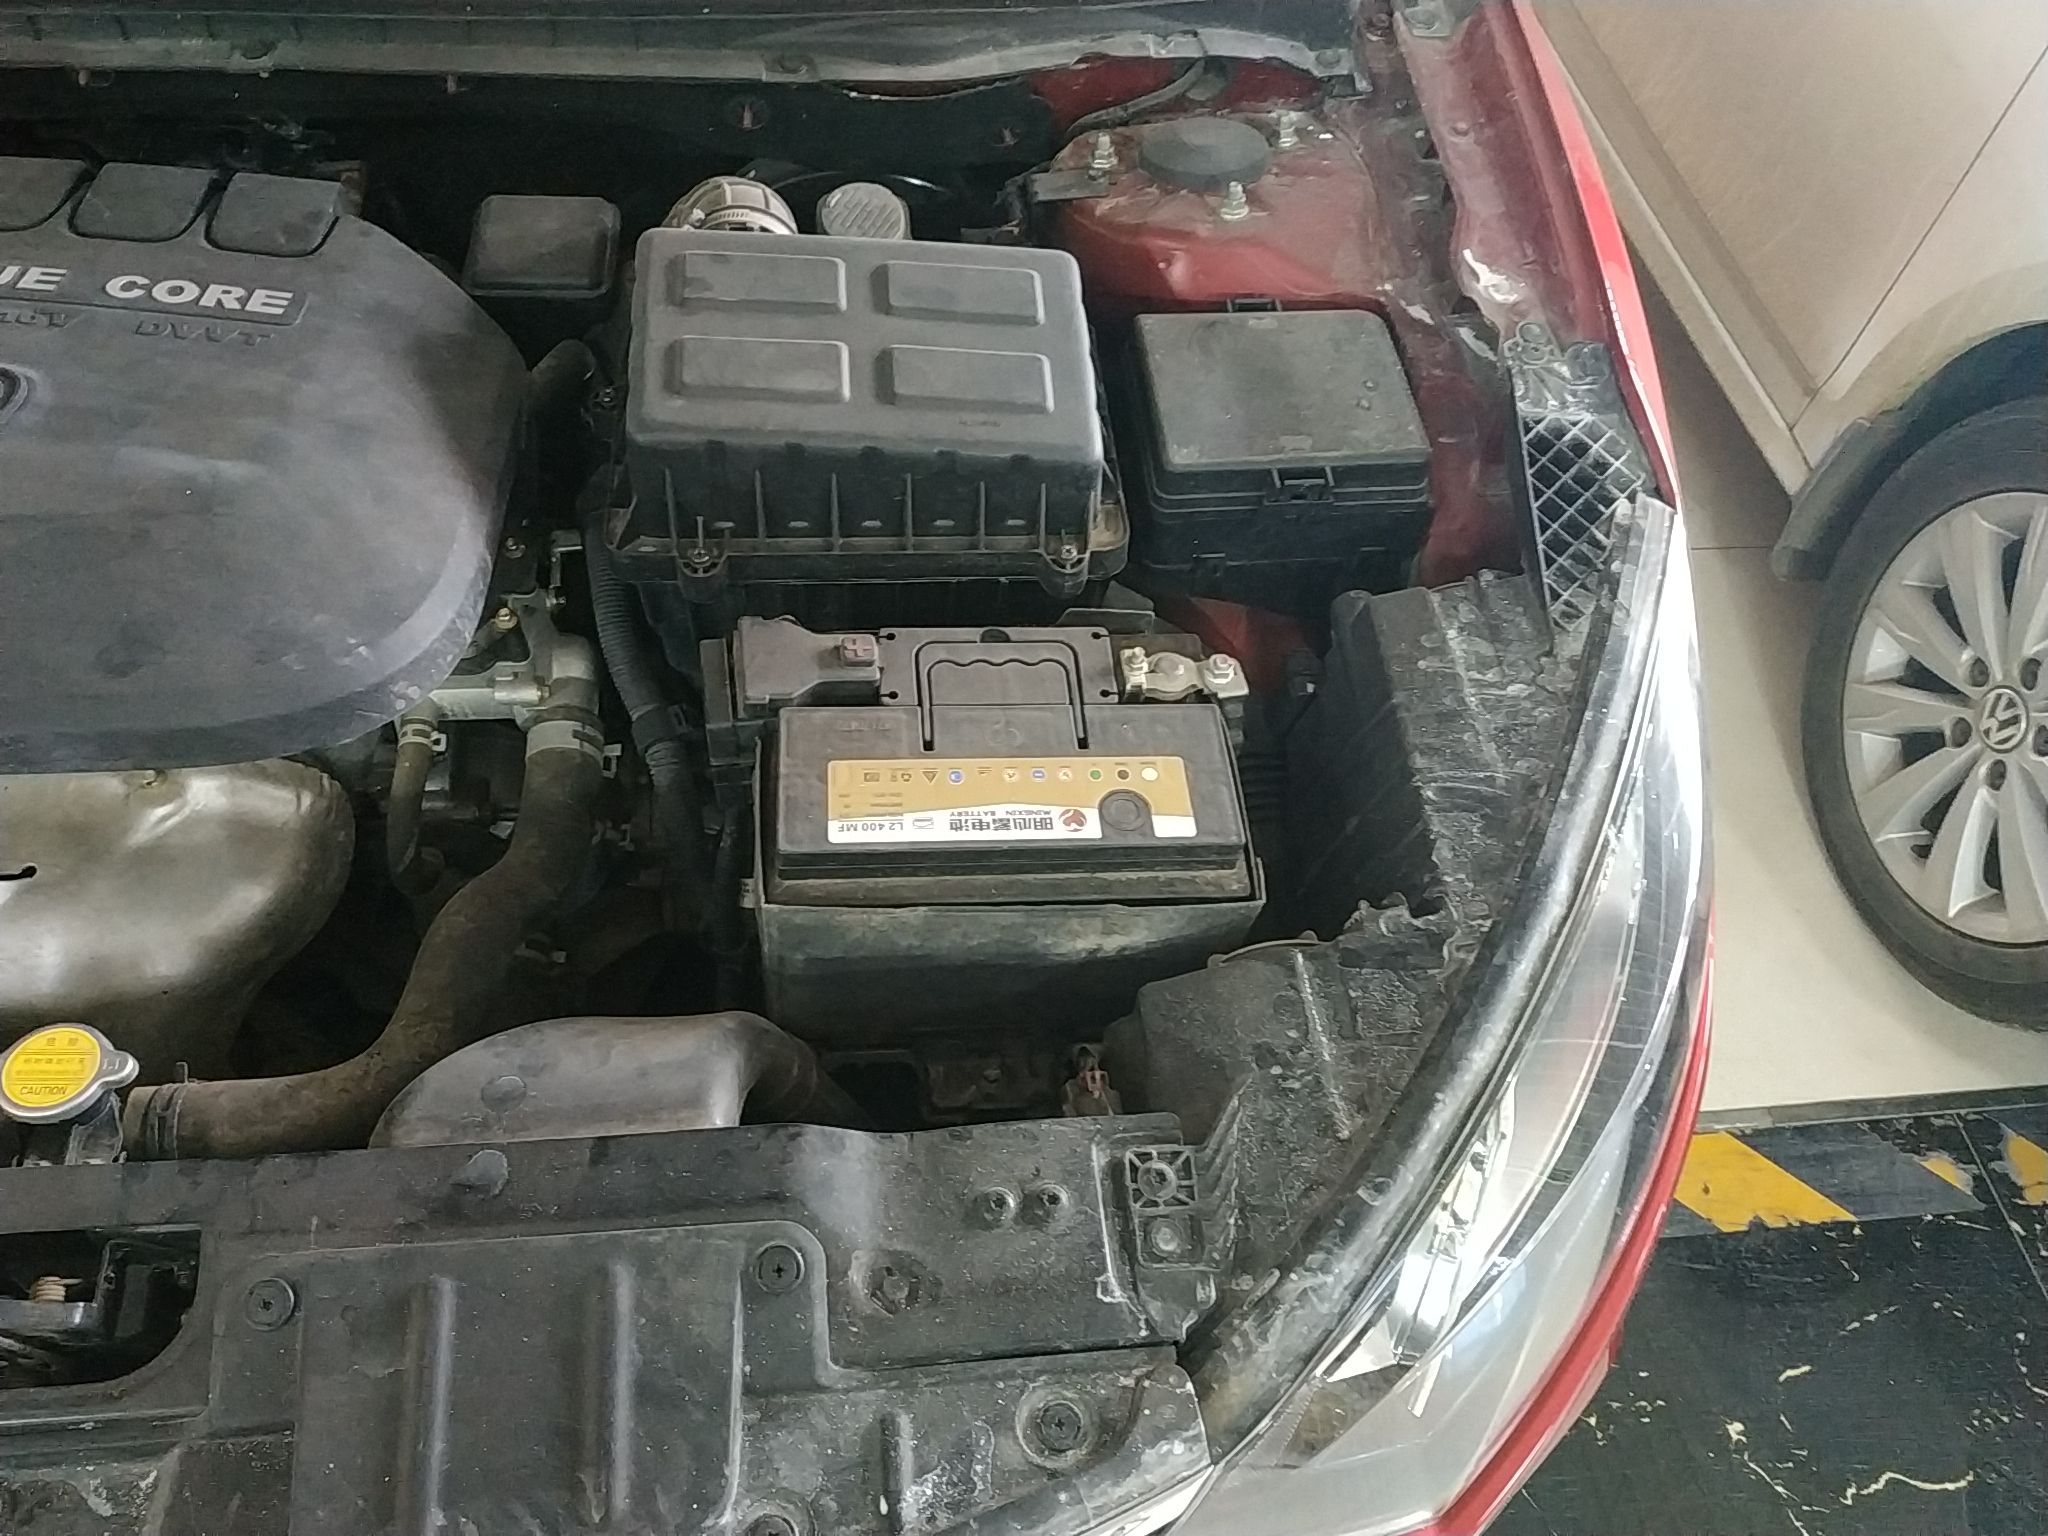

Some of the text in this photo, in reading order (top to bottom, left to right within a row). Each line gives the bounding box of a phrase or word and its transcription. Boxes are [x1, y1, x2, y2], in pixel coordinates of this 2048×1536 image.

[105, 274, 295, 315] CORE
[949, 809, 1052, 817] MINGXIN BATTERY
[837, 822, 904, 832] L2 400 MF
[948, 817, 1054, 833] 明心蓄电池
[19, 1085, 69, 1096] CAUTION
